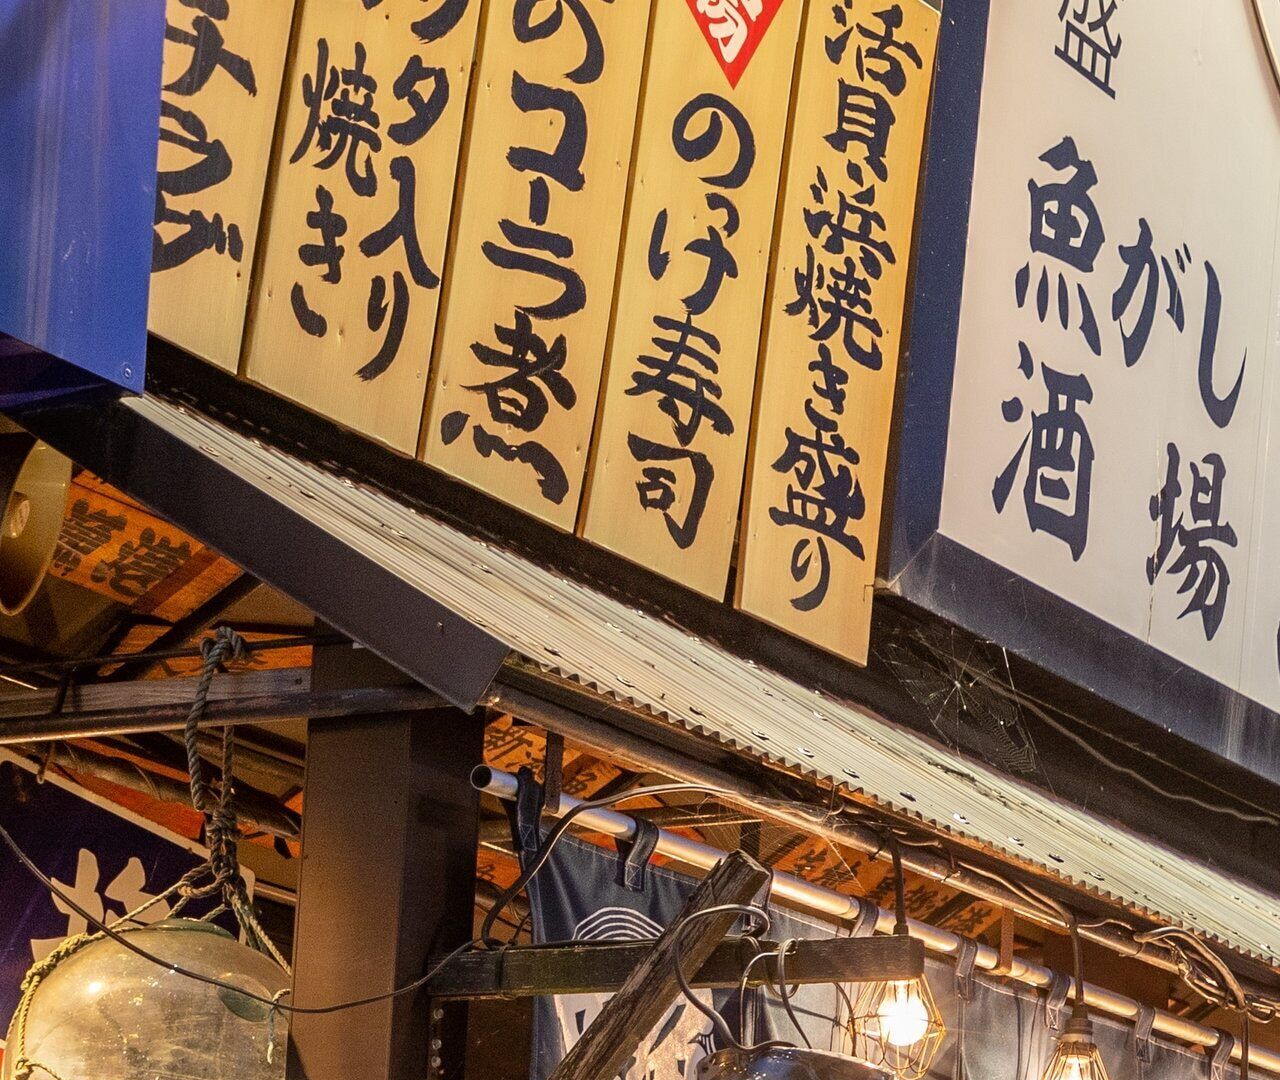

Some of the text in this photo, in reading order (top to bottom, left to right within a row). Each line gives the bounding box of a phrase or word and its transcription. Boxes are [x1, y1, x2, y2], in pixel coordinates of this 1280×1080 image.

[625, 92, 757, 549] のっけ寿司
[1014, 135, 1248, 429] 魚がし
[991, 340, 1238, 642] 酒場
